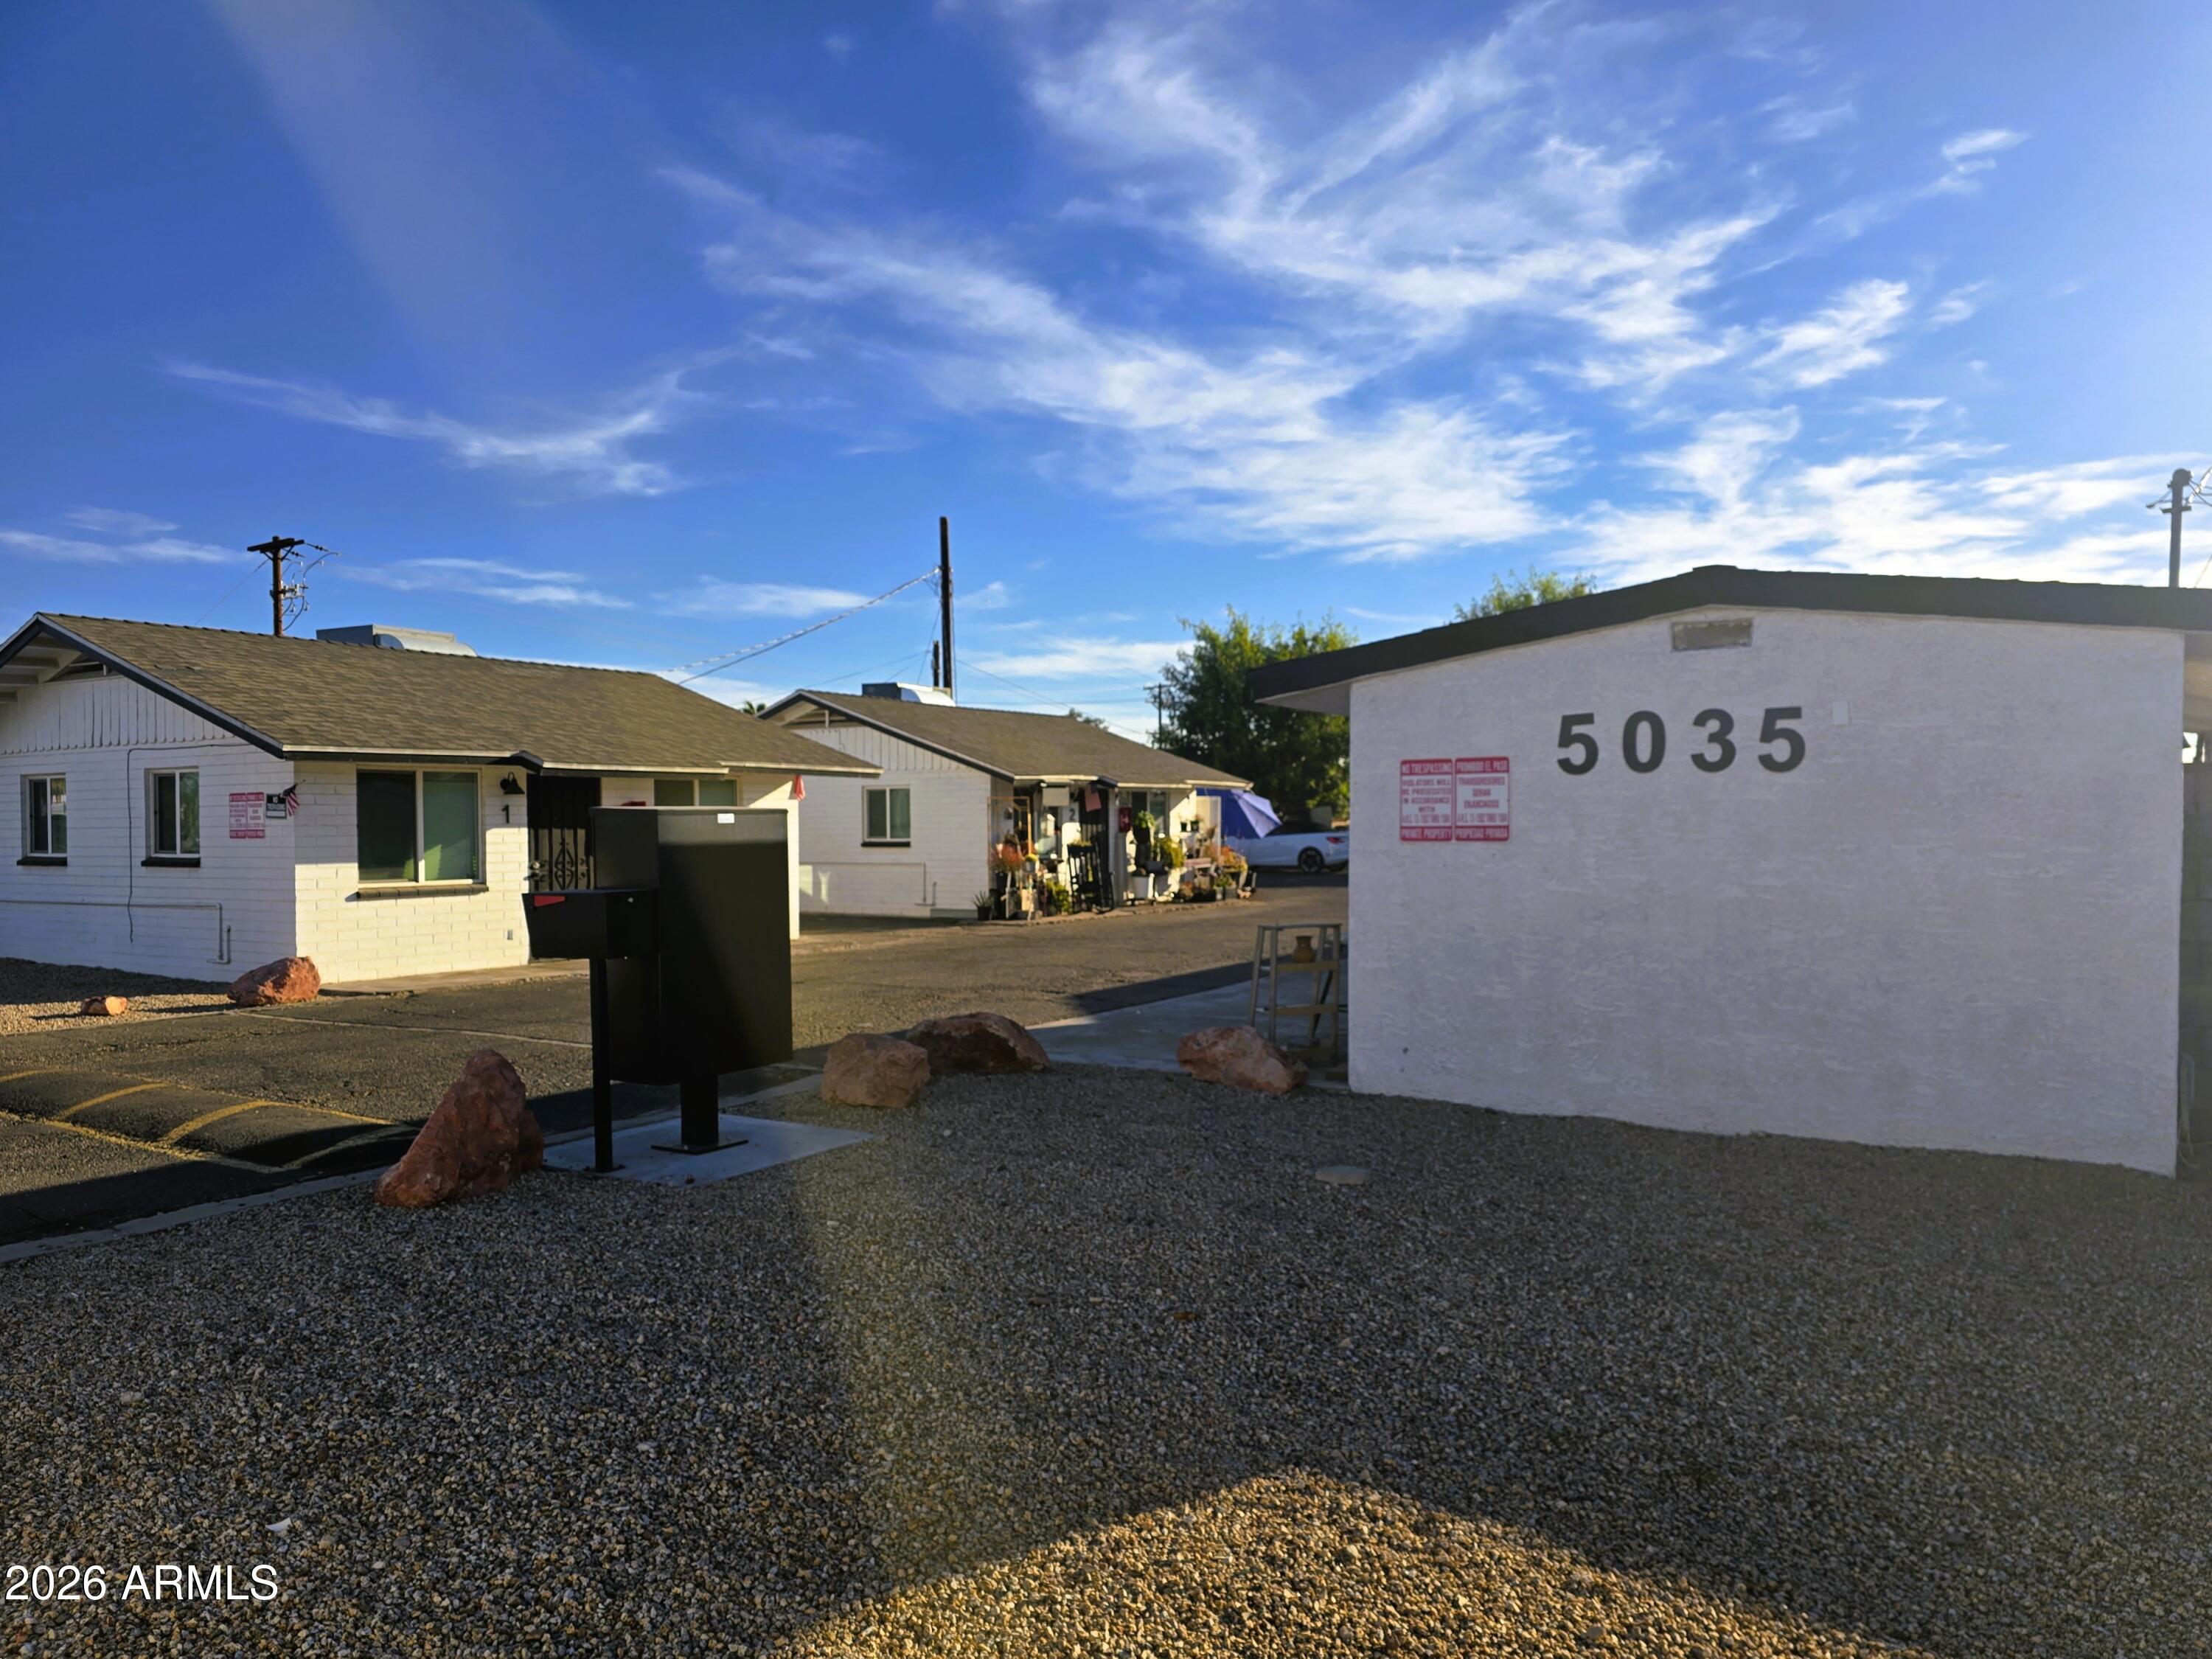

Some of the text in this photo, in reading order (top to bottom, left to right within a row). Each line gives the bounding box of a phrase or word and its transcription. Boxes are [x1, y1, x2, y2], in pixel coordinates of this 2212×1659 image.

[1557, 706, 1806, 776] 5035
[501, 804, 509, 824] 1
[1069, 808, 1076, 821] 2
